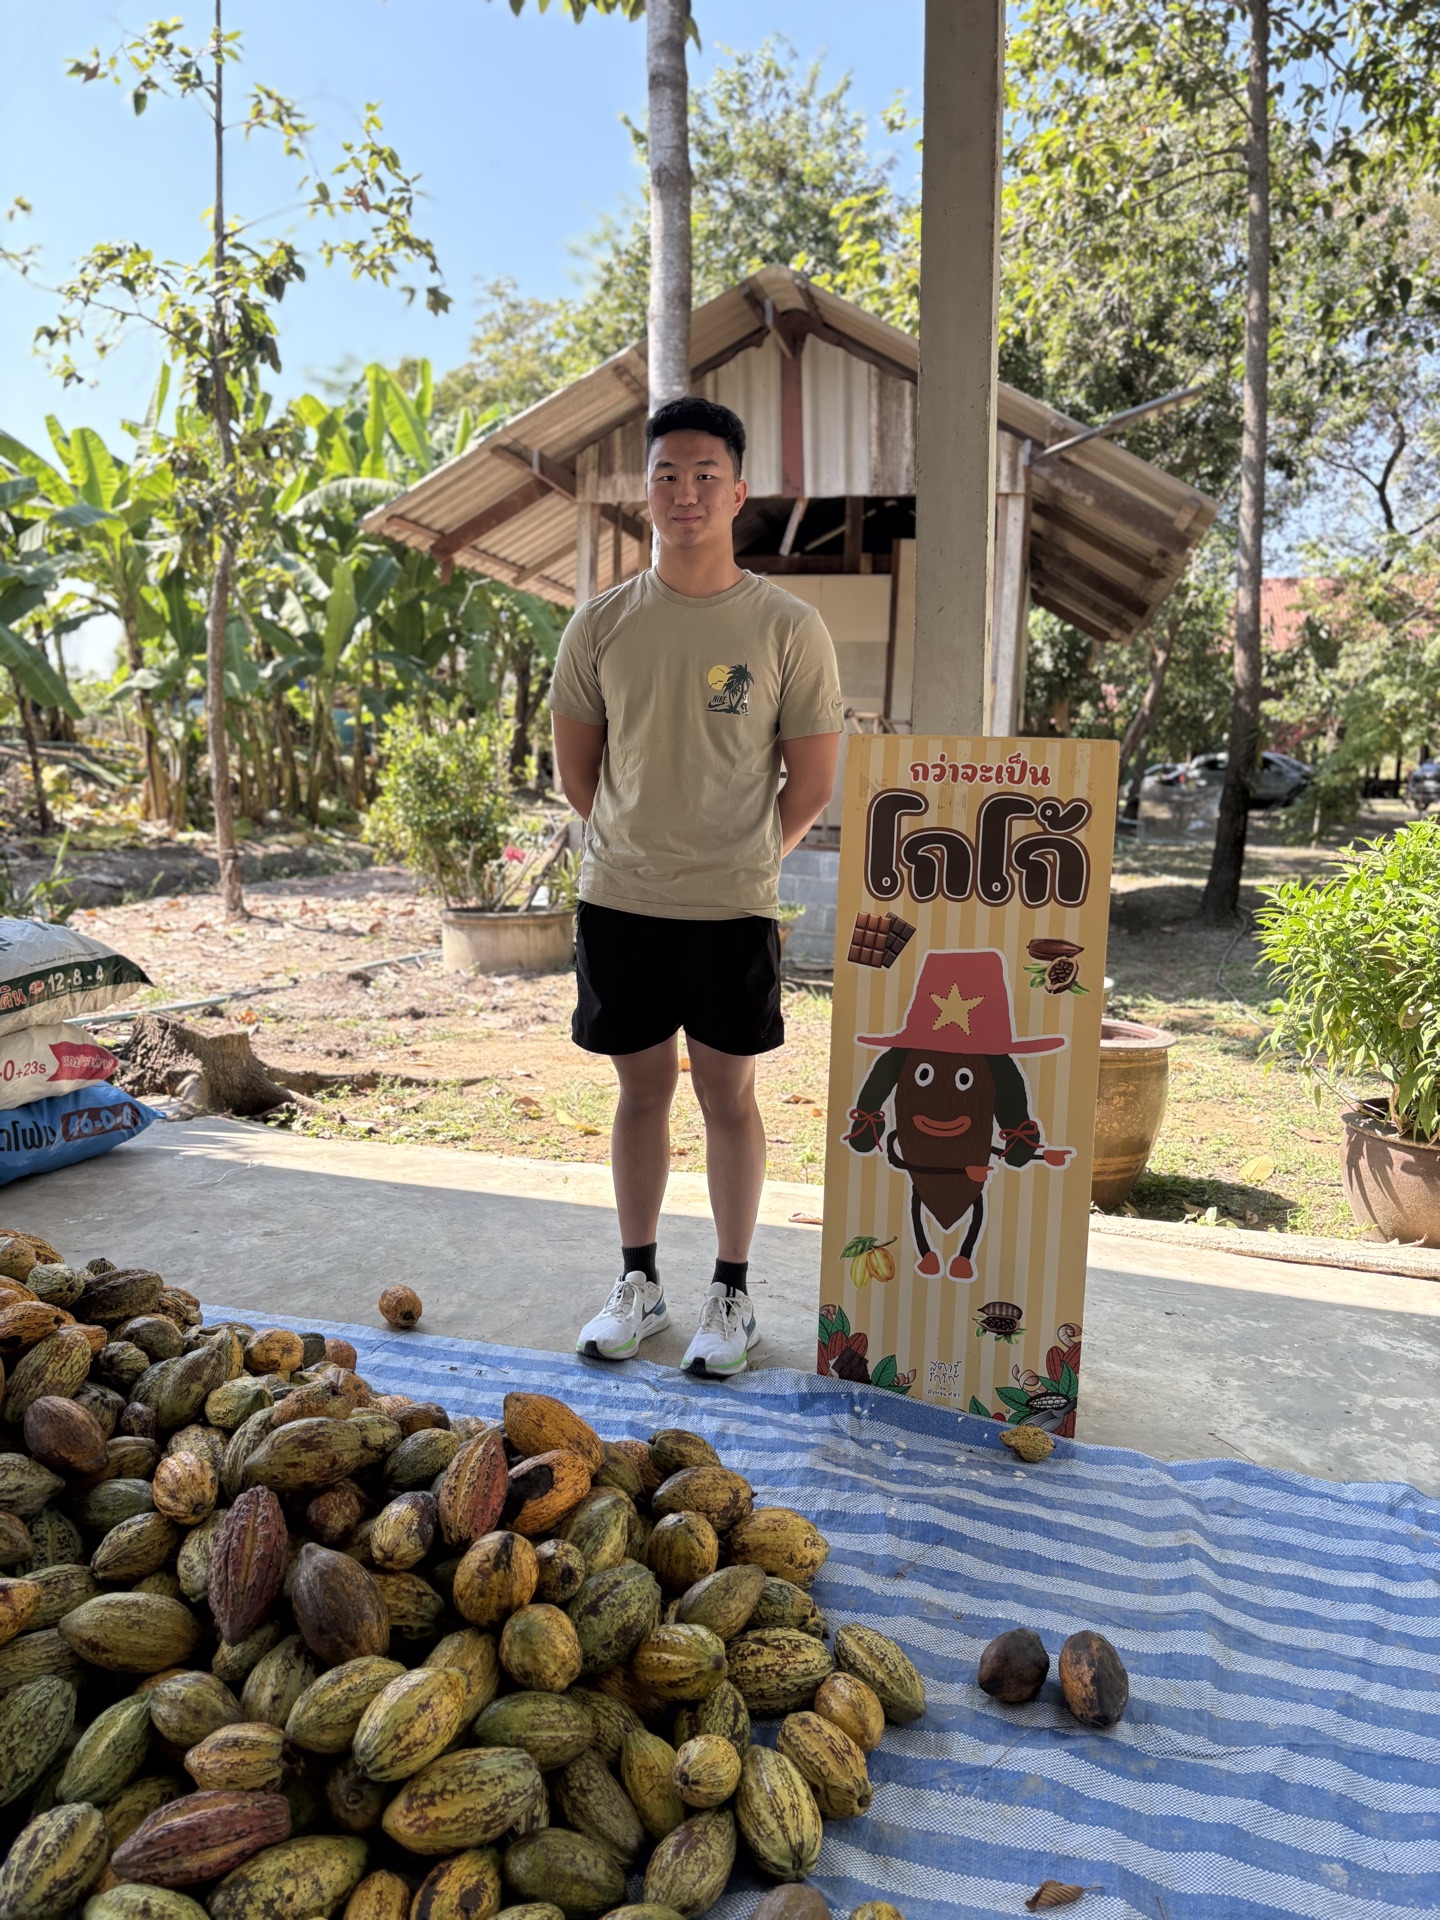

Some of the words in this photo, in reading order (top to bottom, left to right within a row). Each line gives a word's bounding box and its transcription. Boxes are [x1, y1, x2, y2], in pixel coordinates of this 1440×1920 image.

[712, 694, 728, 703] NIKE
[910, 752, 1051, 787] กว่าจะเป็น
[864, 788, 1092, 909] โกโก้
